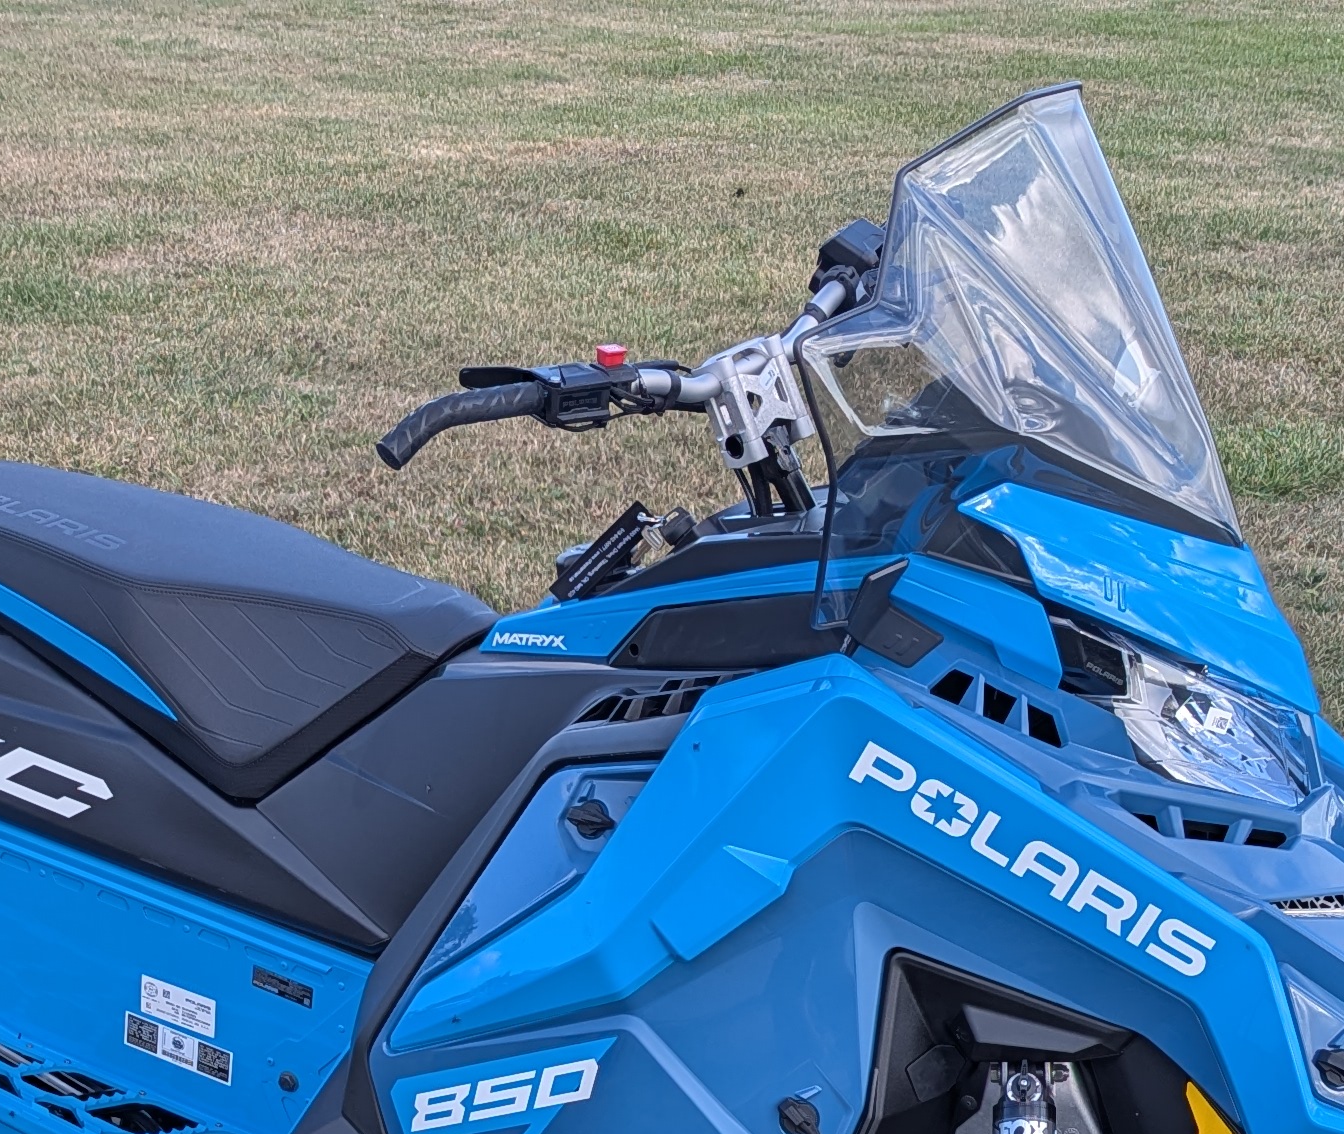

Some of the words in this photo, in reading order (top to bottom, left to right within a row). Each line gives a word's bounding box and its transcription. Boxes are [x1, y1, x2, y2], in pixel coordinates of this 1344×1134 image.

[492, 632, 567, 651] MATRYX
[1086, 661, 1124, 686] POLARIS
[849, 741, 1217, 977] POLARIS
[410, 1058, 599, 1132] 850
